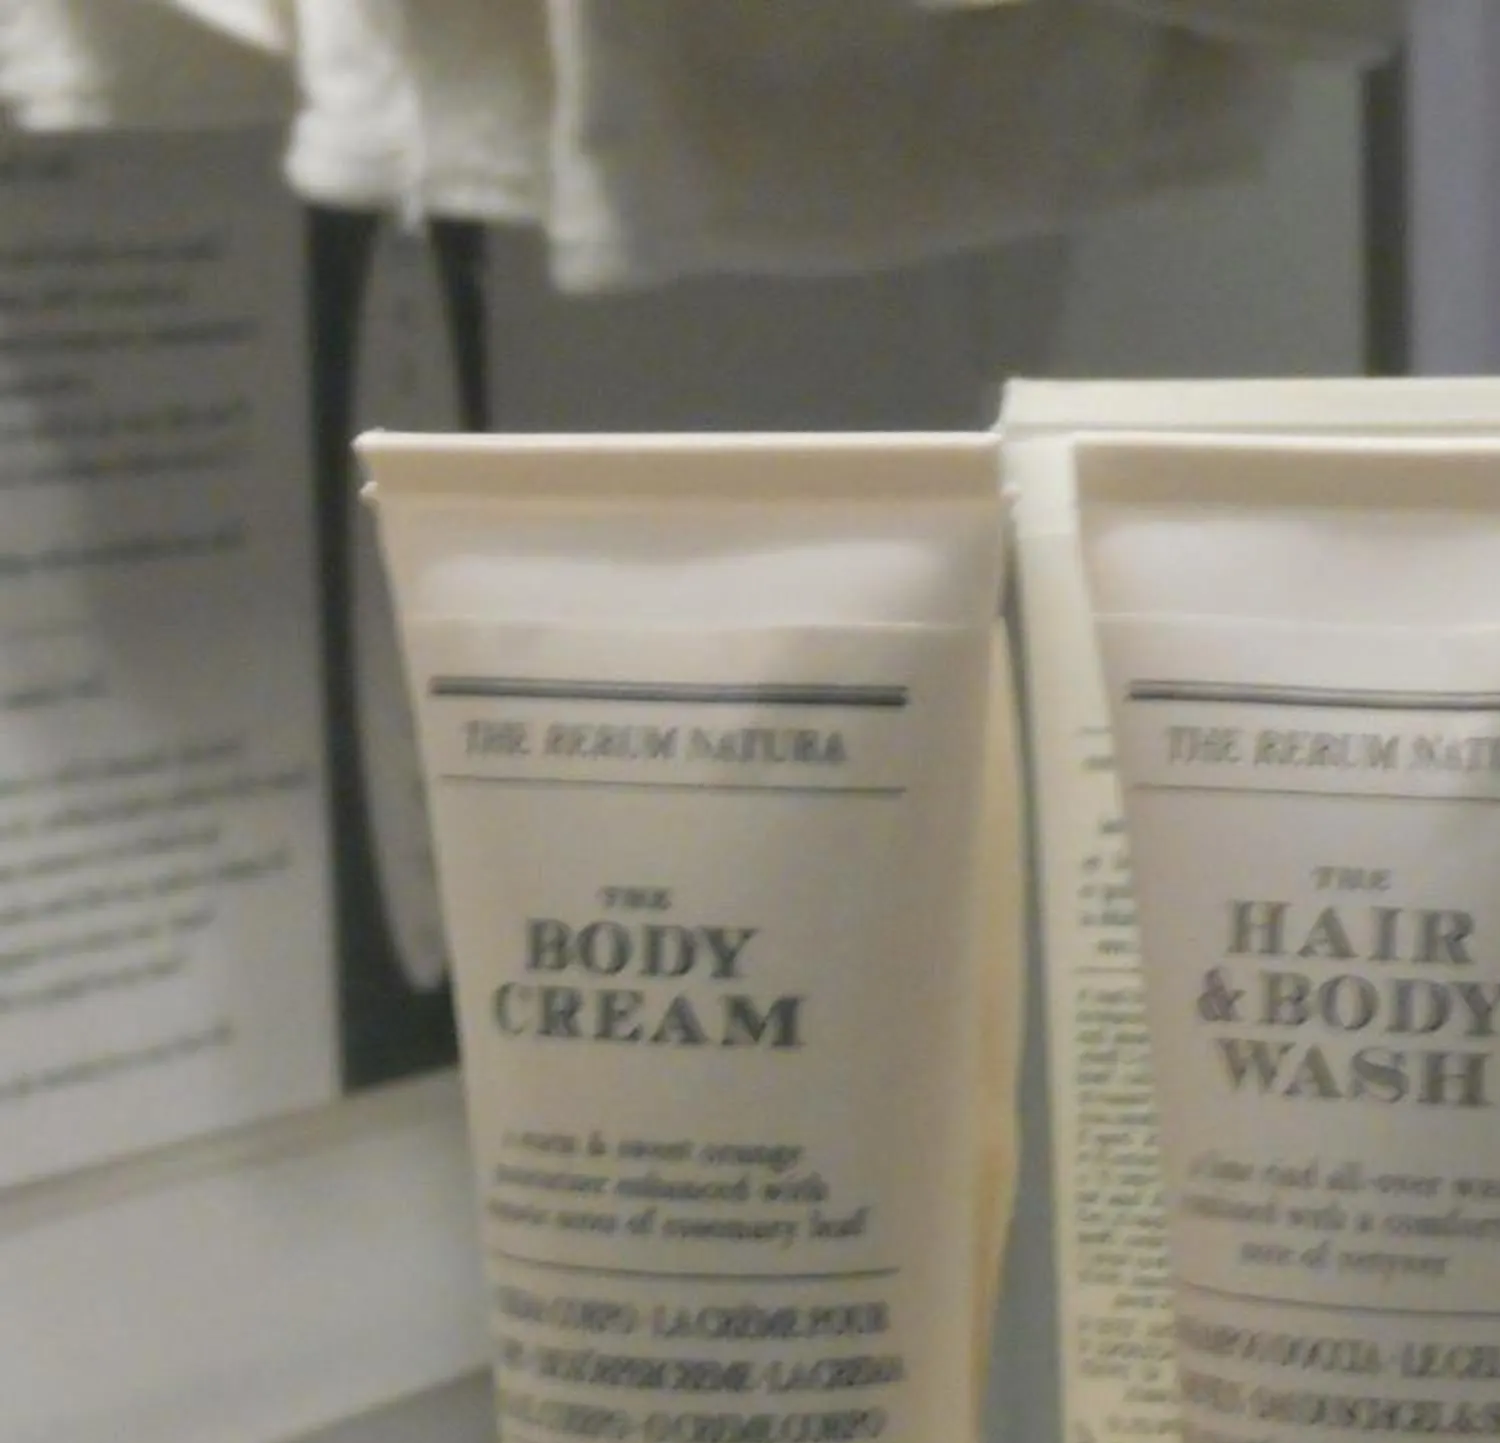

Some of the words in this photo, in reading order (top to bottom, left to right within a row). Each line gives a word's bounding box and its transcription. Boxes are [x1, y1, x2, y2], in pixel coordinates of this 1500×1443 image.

[465, 719, 530, 756] THE
[542, 722, 675, 760] RERUM
[686, 726, 847, 764] NATURA
[1166, 725, 1243, 765] THE
[1253, 729, 1400, 768] RERUM
[600, 886, 673, 911] THE
[1311, 866, 1393, 891] THE
[525, 917, 760, 980] BODY
[1223, 899, 1477, 965] HAIR
[493, 982, 808, 1049] CREAM
[1214, 1037, 1498, 1108] WASH
[762, 1171, 830, 1204] with
[625, 1206, 658, 1236] of
[808, 1204, 871, 1240] leaf
